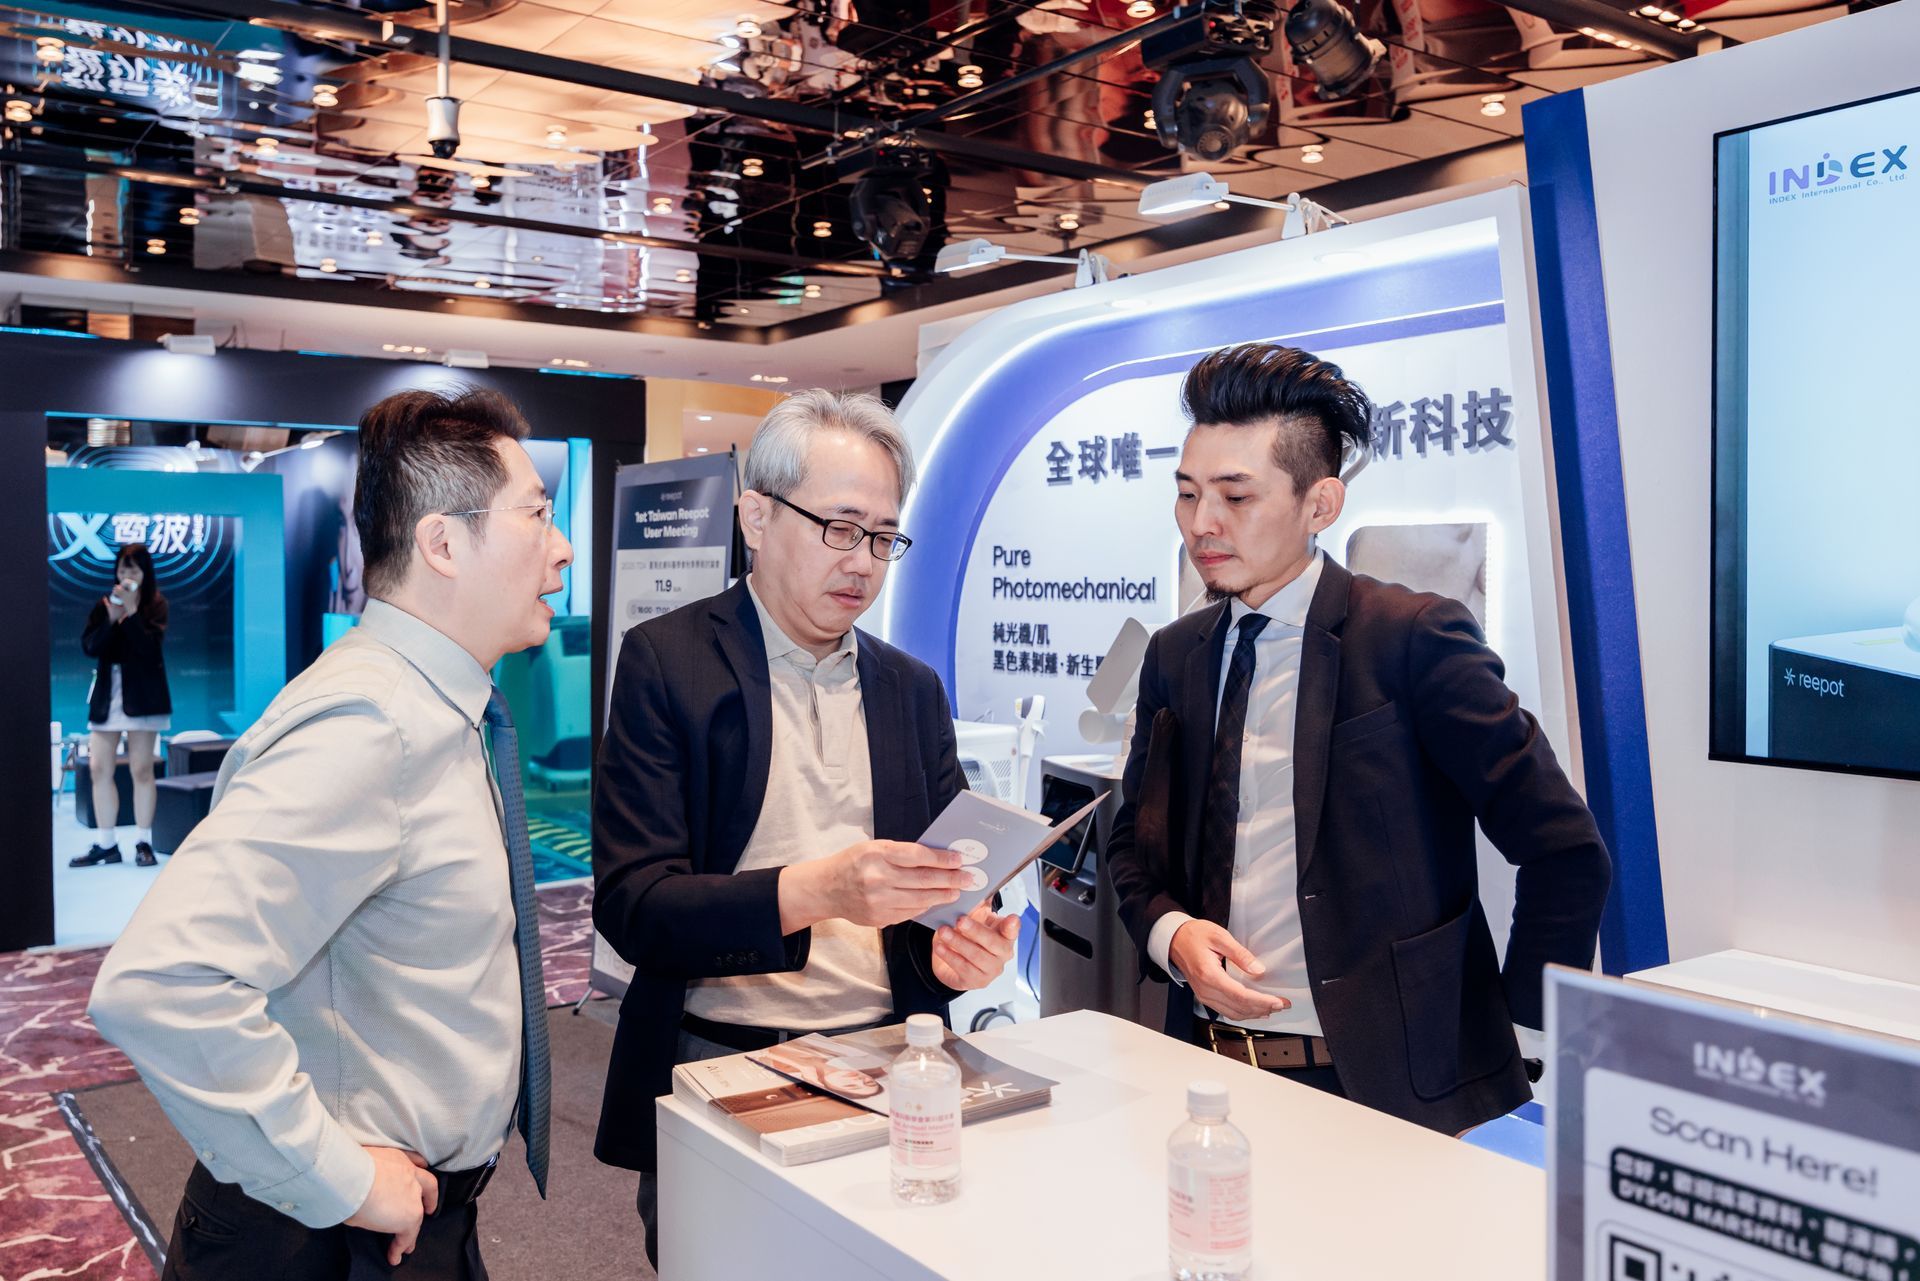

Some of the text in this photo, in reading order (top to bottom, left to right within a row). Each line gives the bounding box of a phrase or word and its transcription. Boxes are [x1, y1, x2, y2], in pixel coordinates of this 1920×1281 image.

[1769, 145, 1907, 195] INDEX
[1769, 193, 1797, 204] INDEX
[1801, 182, 1861, 199] International
[1046, 432, 1180, 483] 全球唯一
[635, 506, 710, 523] 1st Taiwan Reepot
[643, 523, 699, 539] User Meeting
[993, 545, 1031, 568] Pure
[655, 579, 672, 592] 11.9
[993, 576, 1157, 602] Photomechanical
[1798, 673, 1845, 697] reepot
[1693, 1042, 1826, 1101] INDEX
[1650, 1106, 1878, 1198] Scan Here!
[1618, 1177, 1690, 1218] DYSON
